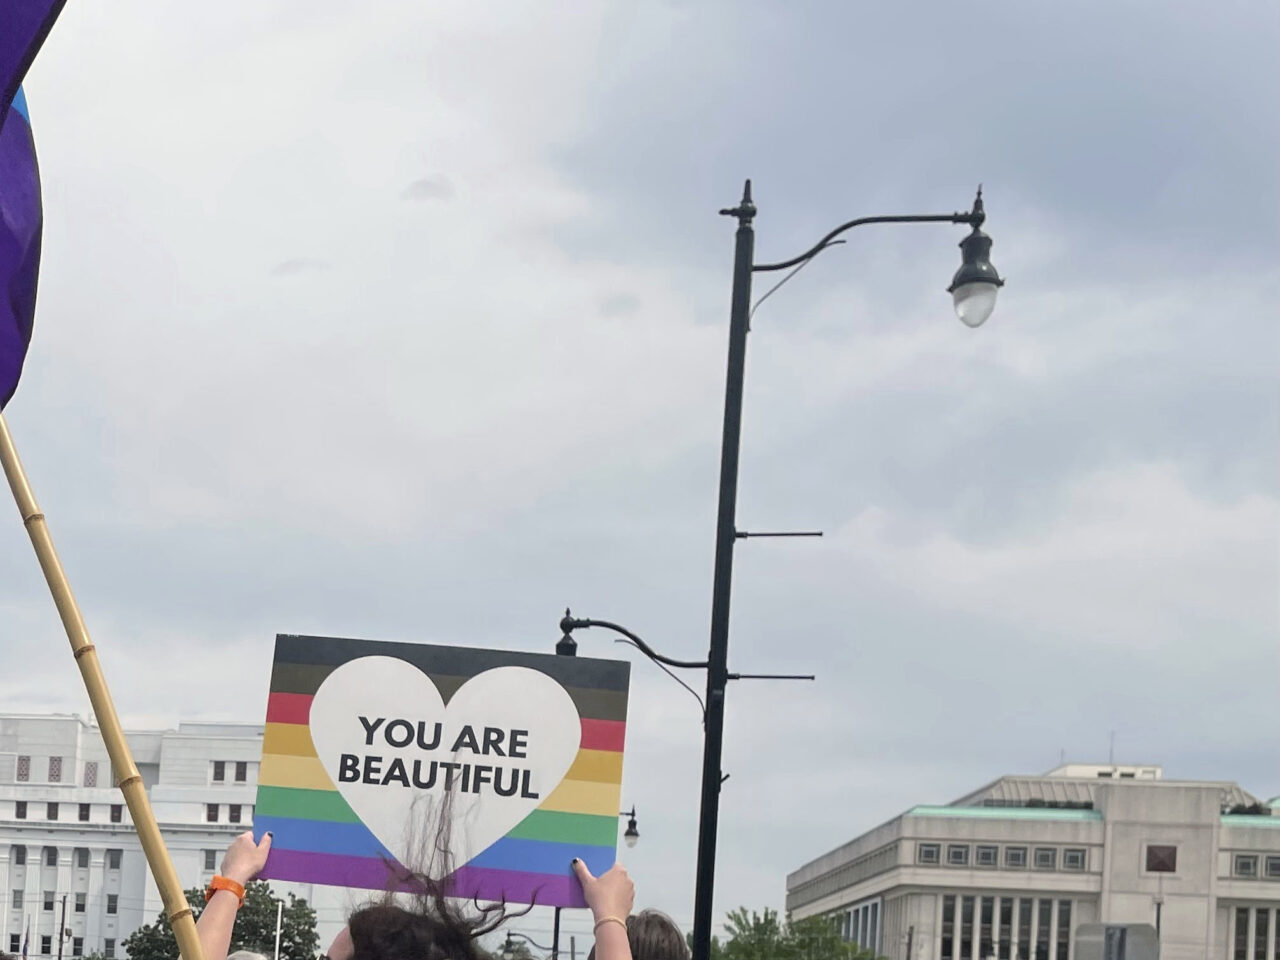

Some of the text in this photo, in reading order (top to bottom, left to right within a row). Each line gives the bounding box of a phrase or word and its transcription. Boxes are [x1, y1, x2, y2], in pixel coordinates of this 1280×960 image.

[358, 716, 529, 758] YOU ARE
[339, 753, 539, 799] BEAUTIFUL
